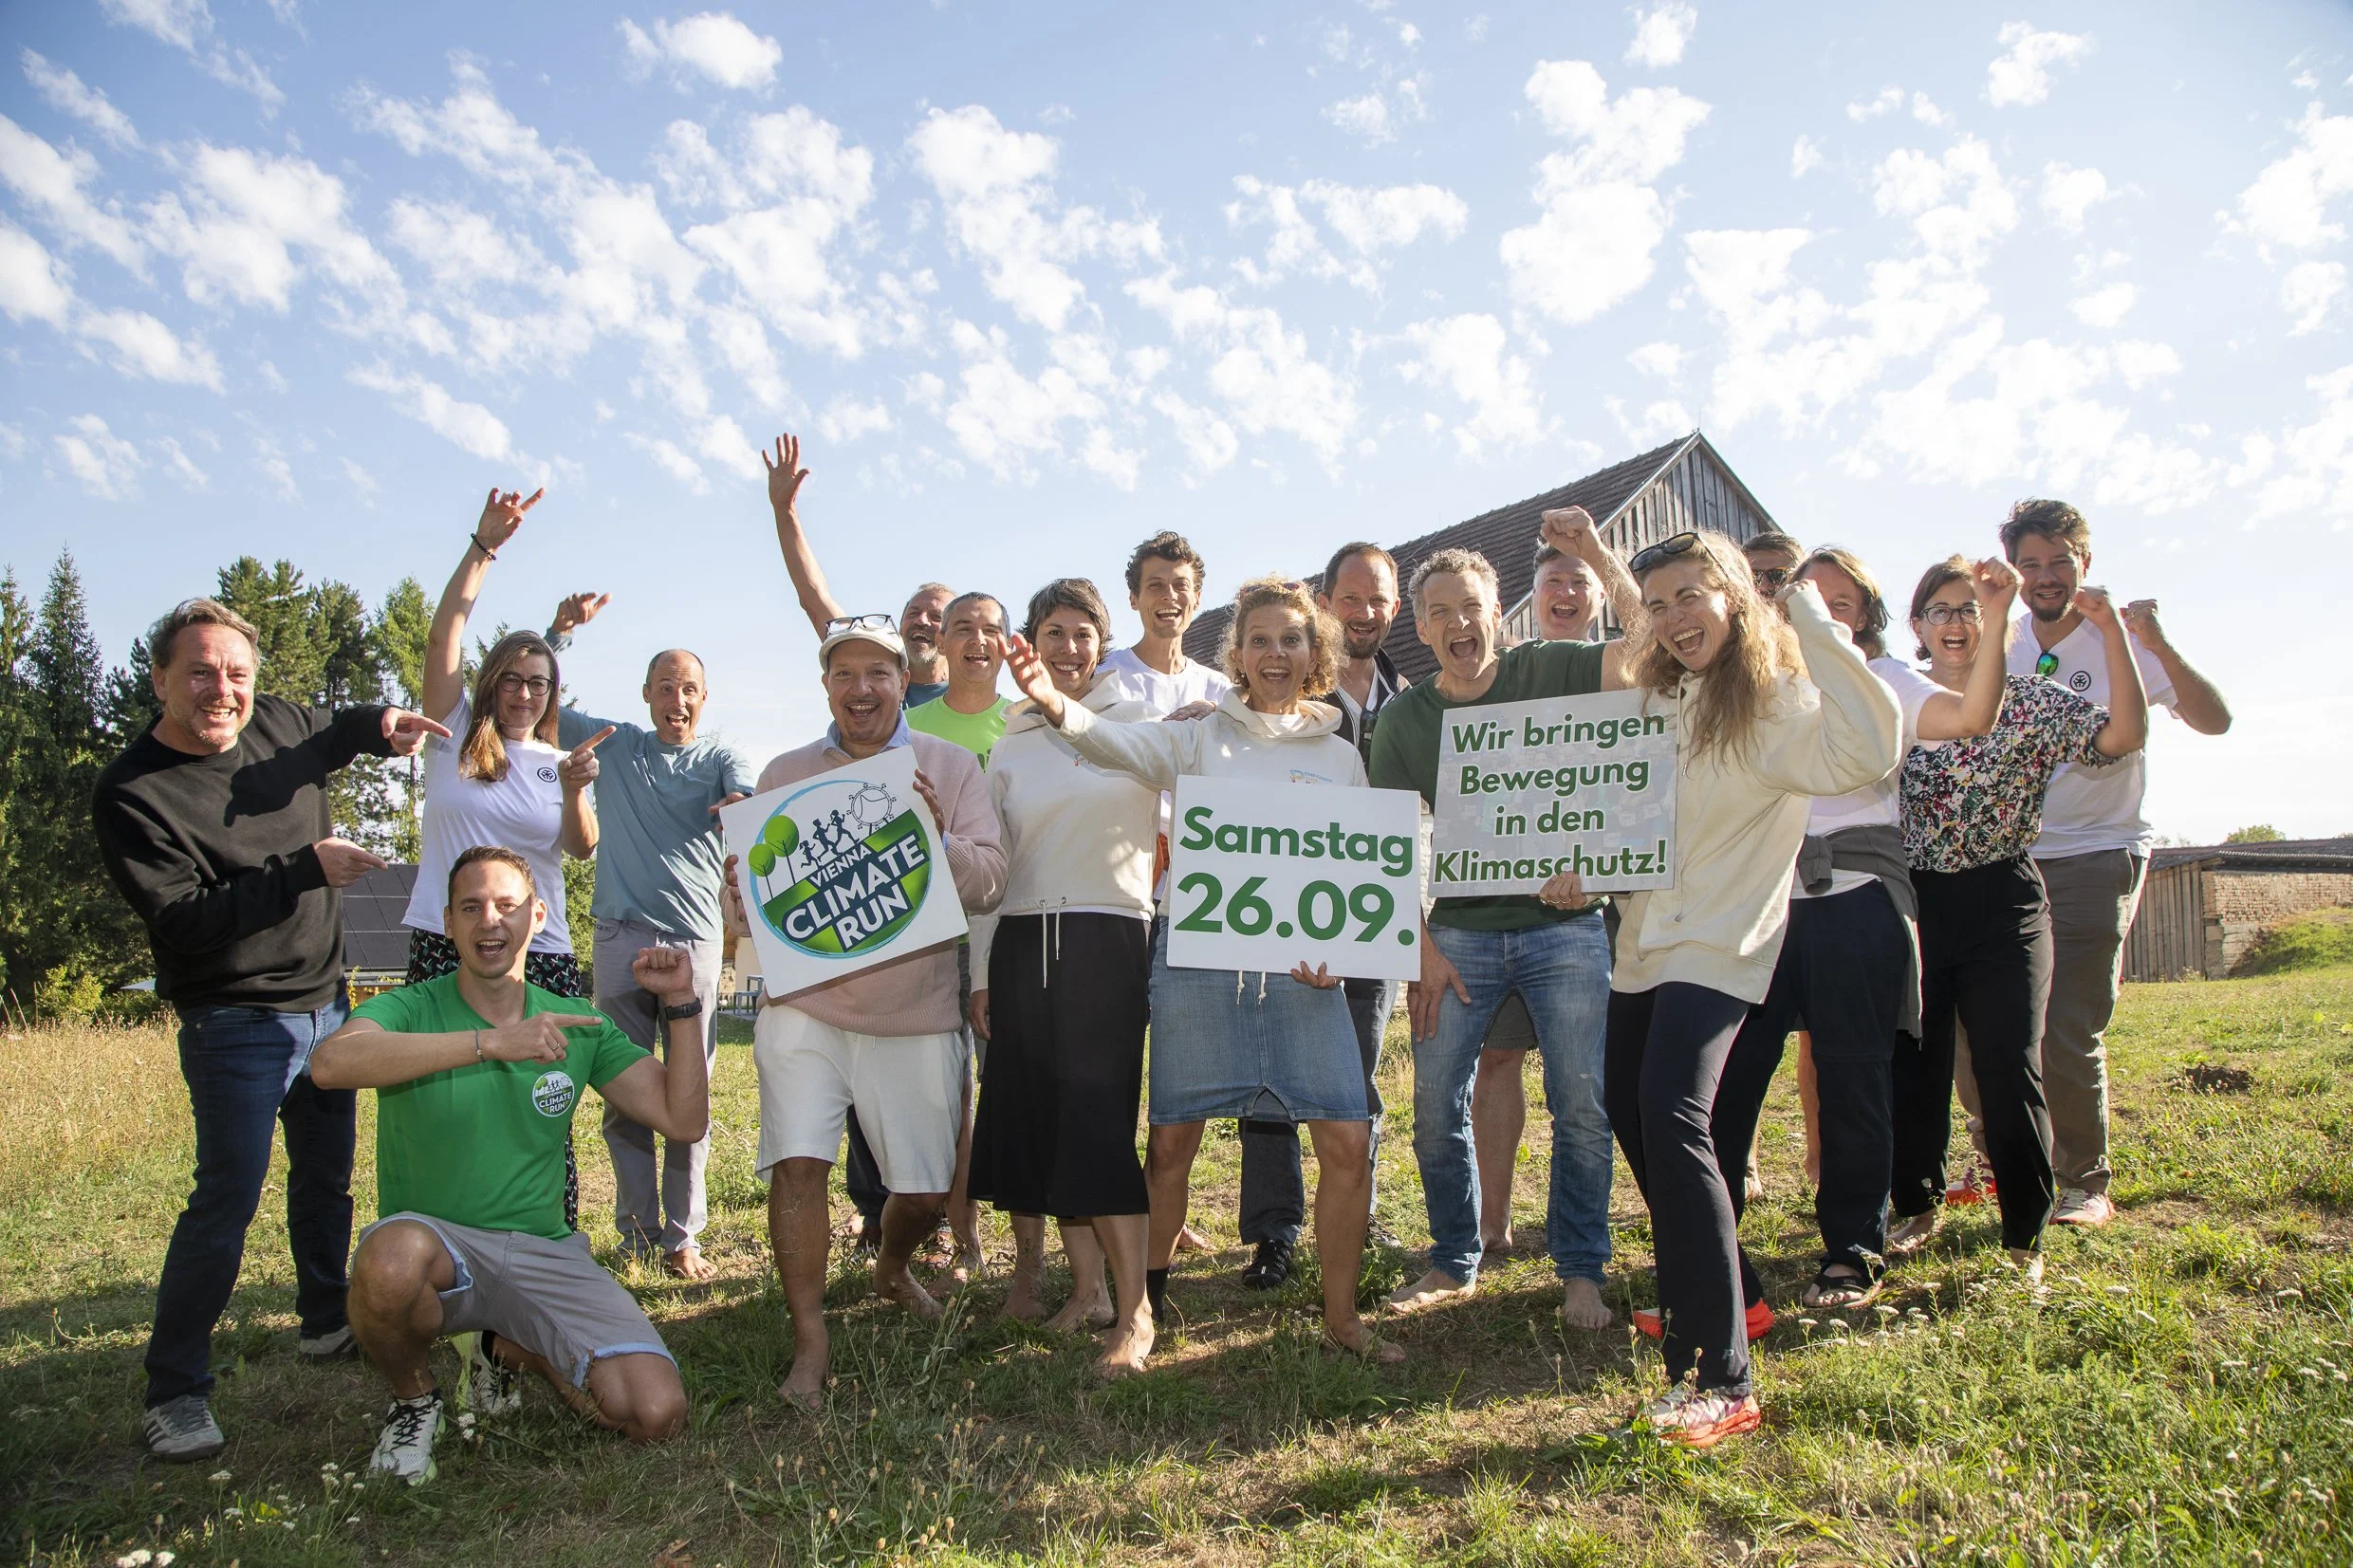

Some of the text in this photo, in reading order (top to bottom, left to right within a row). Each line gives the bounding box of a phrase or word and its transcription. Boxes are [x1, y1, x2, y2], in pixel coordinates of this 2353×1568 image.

[1452, 713, 1664, 753] Wir bringen
[1460, 761, 1649, 796] Bewegung
[1495, 801, 1604, 835] in den
[1179, 806, 1413, 876] Samstag
[1434, 839, 1667, 883] Klimaschutz!
[787, 835, 925, 938] CLIMATE
[810, 844, 872, 887] VIENNA
[838, 885, 908, 949] RUN
[1175, 872, 1415, 946] 26.09.
[539, 1091, 571, 1108] CLIMATE
[550, 1102, 565, 1113] RUN
